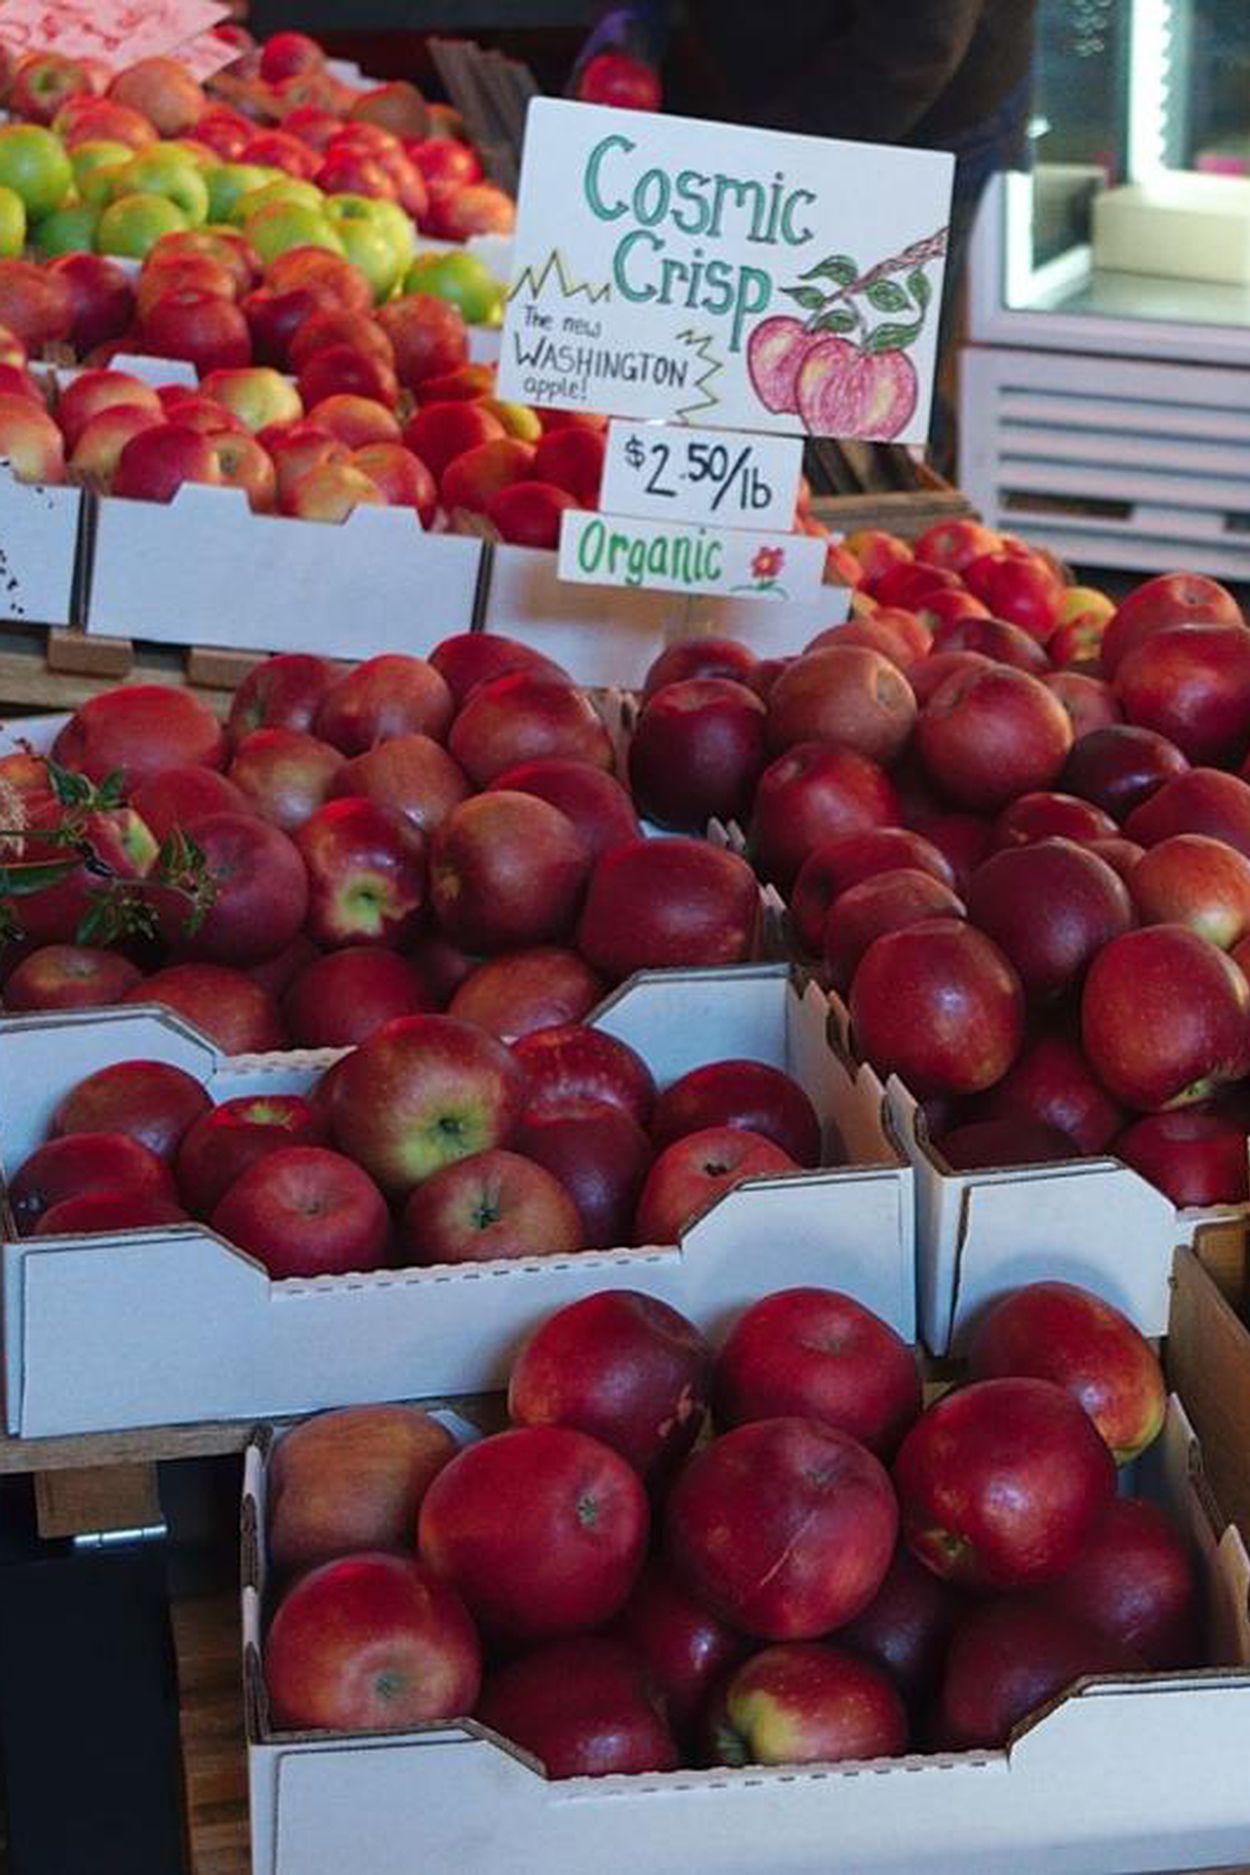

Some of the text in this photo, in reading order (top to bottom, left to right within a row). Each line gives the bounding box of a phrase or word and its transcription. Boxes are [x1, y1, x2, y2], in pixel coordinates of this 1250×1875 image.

[584, 134, 817, 246] Cosmic
[523, 305, 601, 338] The new
[613, 229, 774, 353] Crisp
[513, 331, 689, 388] WASHINGTON
[523, 376, 588, 400] apple!
[578, 519, 723, 586] Organic
